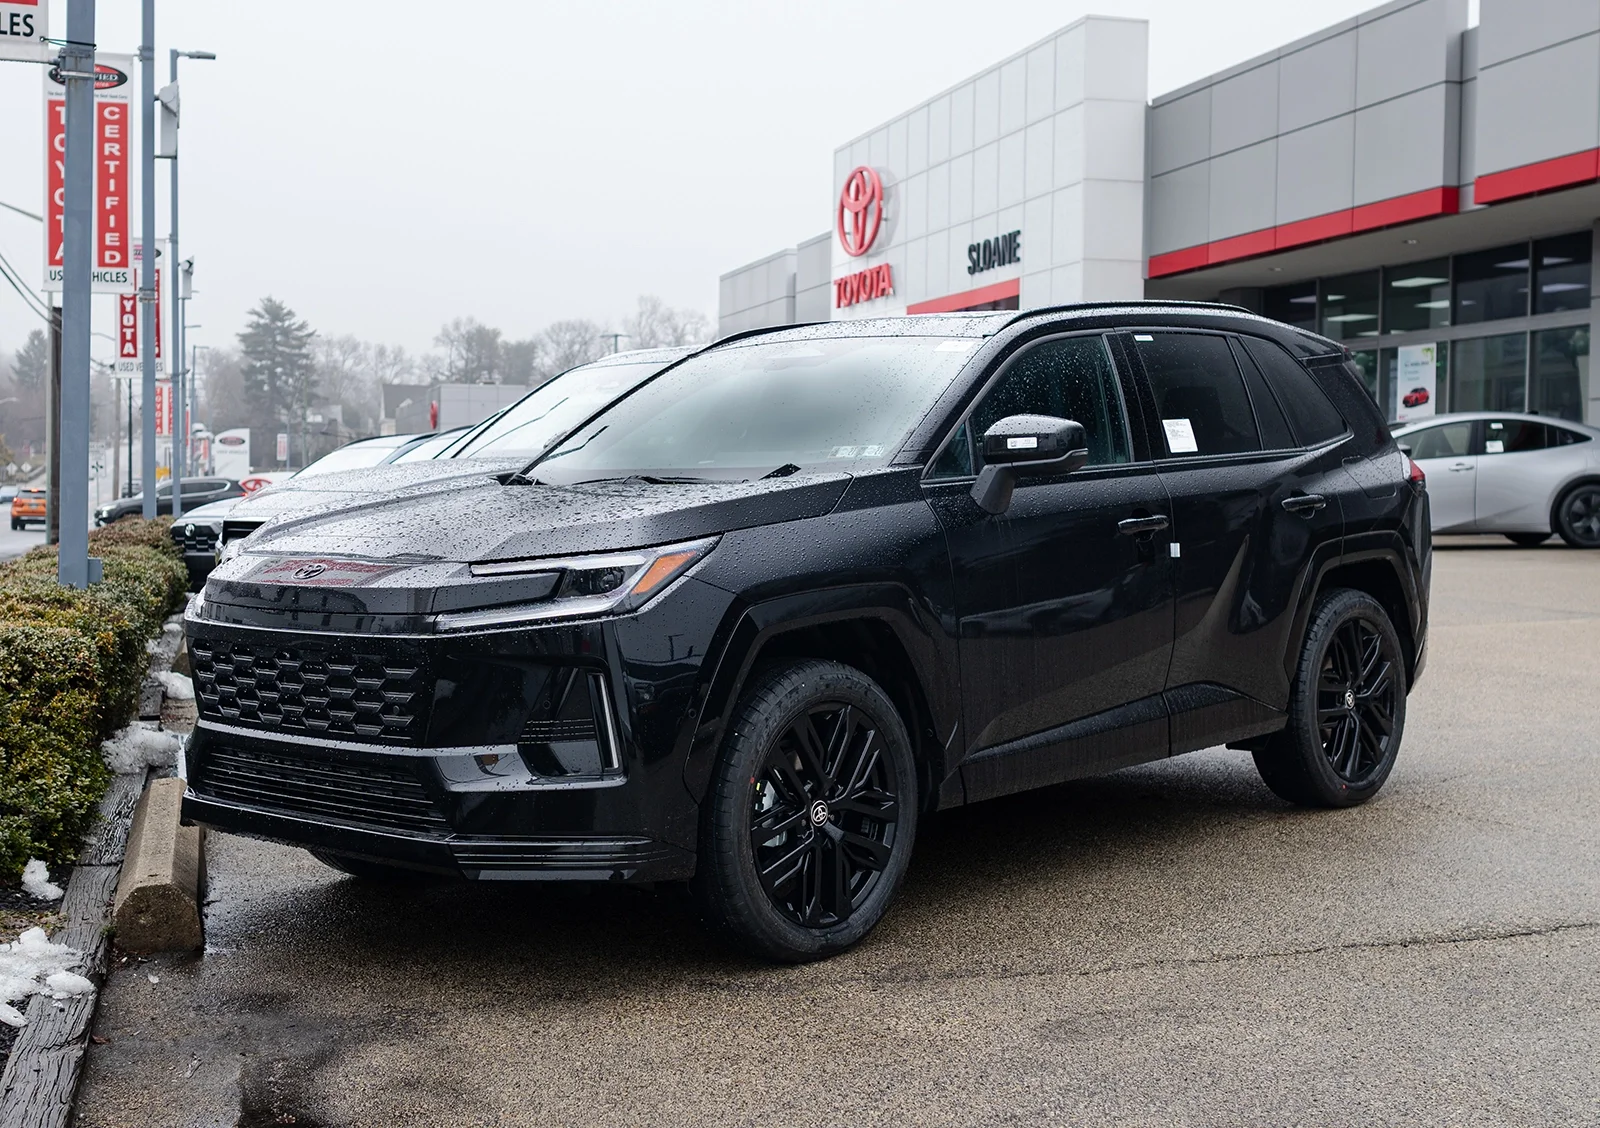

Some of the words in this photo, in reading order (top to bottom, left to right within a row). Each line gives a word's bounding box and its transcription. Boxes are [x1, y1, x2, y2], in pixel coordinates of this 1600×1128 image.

[103, 106, 121, 264] CERTIFIED
[967, 230, 1021, 275] SLOANE
[49, 269, 64, 282] US
[92, 271, 128, 283] HICLES
[834, 263, 892, 309] TOYOTA
[122, 294, 136, 355] YOTA
